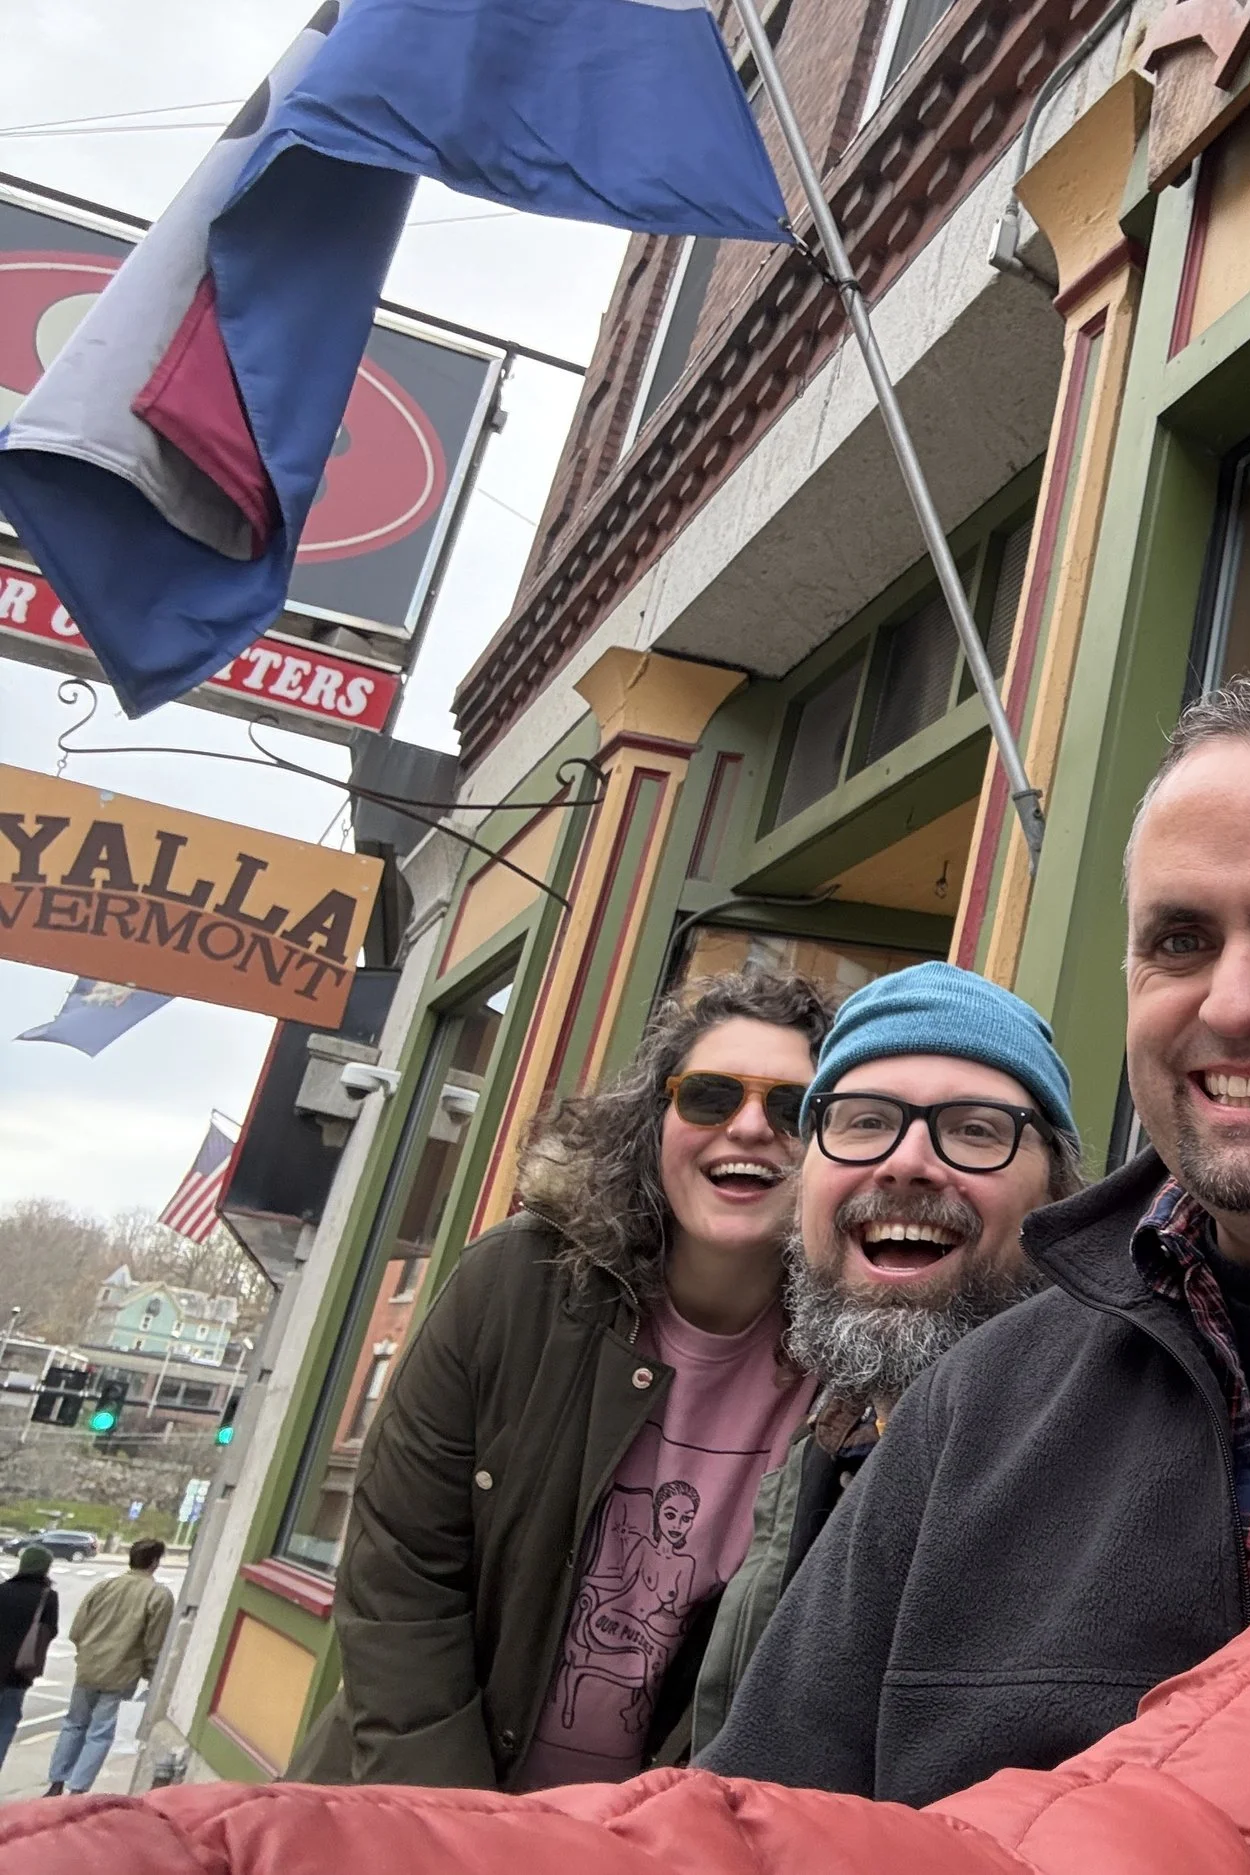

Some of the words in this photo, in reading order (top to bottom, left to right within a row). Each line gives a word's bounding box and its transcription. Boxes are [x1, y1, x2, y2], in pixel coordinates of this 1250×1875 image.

[0, 576, 36, 624] R
[0, 812, 357, 965] YALLA
[595, 1614, 619, 1635] OUR
